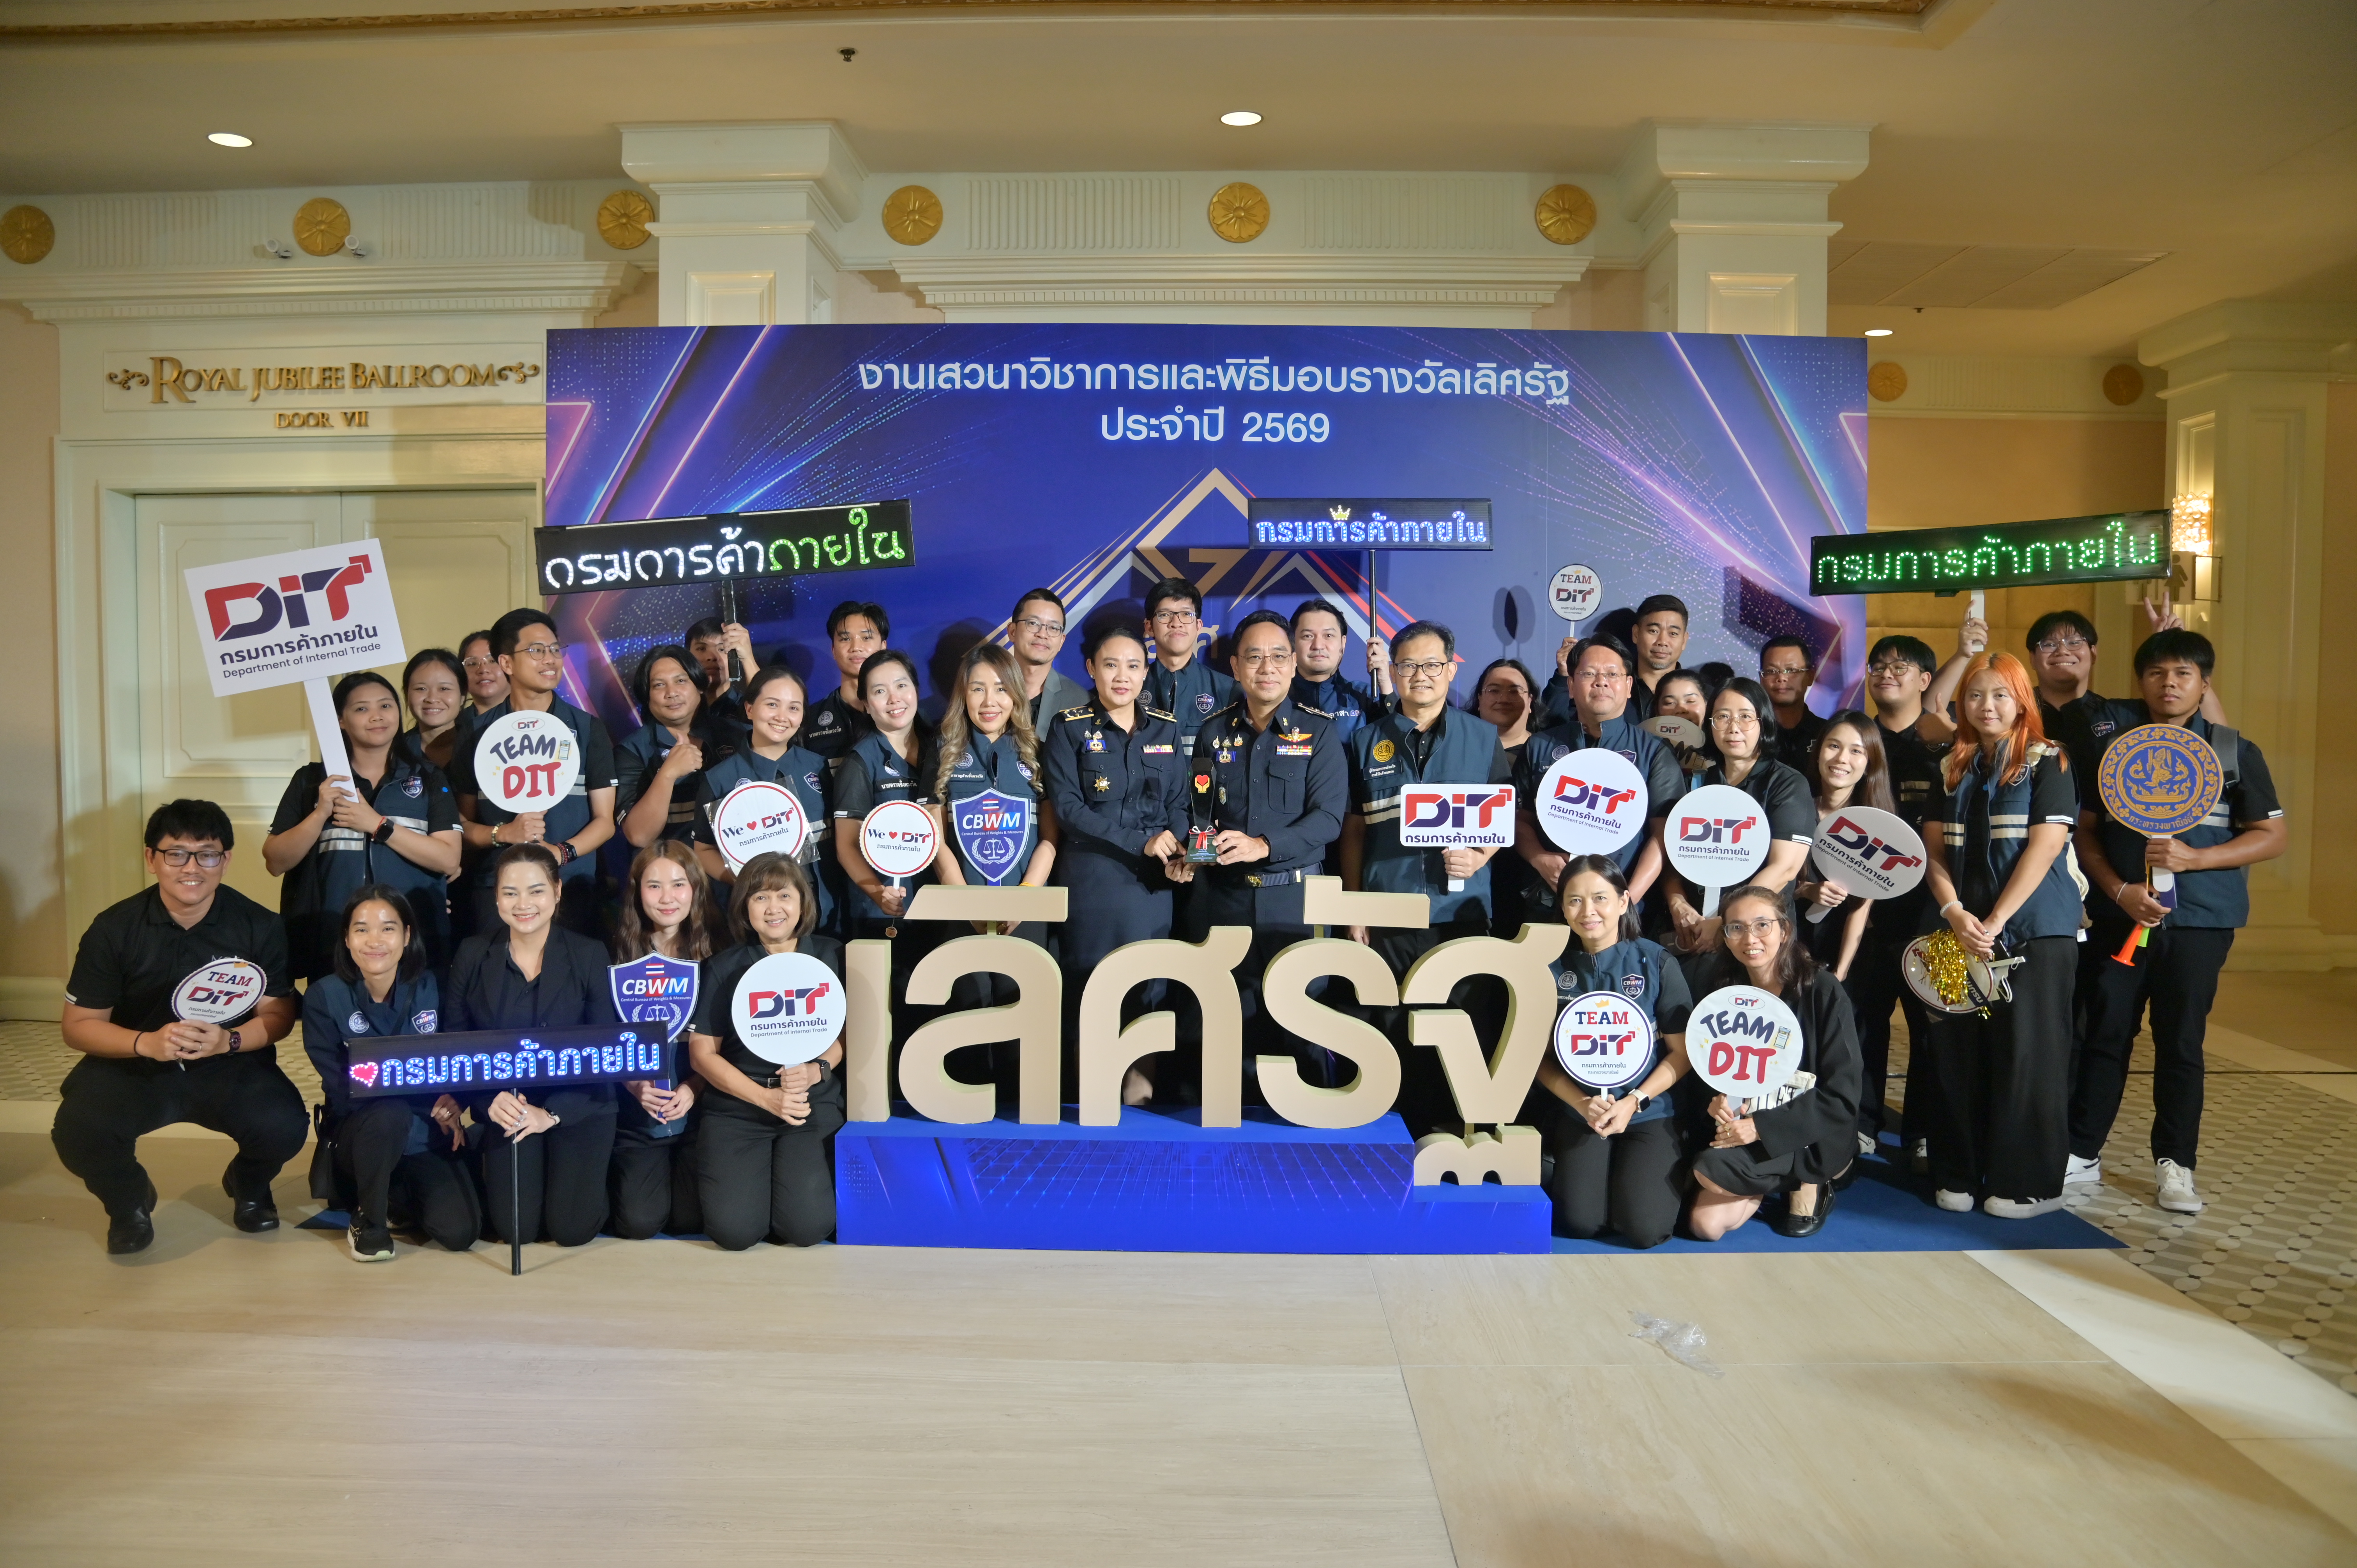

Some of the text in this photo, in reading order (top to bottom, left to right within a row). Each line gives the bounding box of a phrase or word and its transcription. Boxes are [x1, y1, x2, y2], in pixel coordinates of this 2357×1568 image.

[149, 356, 499, 404] ROYAL JUBILEE BALLROOM
[859, 357, 1569, 405] งานเสวนาวิชาการและพิธีมอบรางวัลเลิศรัฐ
[275, 411, 369, 429] DOOR VII
[1101, 405, 1330, 443] ประจำปี 2569
[1256, 511, 1487, 542] กรมการค้าภายใน
[545, 508, 905, 588] กรมการค้าภายใน
[1817, 521, 2157, 583] กรมการค้าภายใน
[1560, 574, 1592, 584] TEAM
[220, 624, 378, 665] กรมการค้าภายใน
[223, 643, 381, 678] Department of Internal Trade
[490, 734, 556, 764] TEAM
[503, 762, 562, 799] DIT
[962, 813, 1020, 829] CBWM
[1548, 812, 1578, 823] Department
[1584, 822, 1604, 831] Internal
[1550, 804, 1622, 829] กรมการค้าภายใน
[721, 826, 744, 839] We
[739, 828, 789, 846] กรมการค้าภายใน
[868, 828, 885, 839] We
[1405, 832, 1505, 844] กรมการค้าภายใน
[1679, 846, 1750, 856] กรมการค้าภายใน
[1819, 839, 1895, 888] กรมการค้าภายใน
[1815, 844, 1846, 866] Department
[1852, 867, 1874, 882] Internal
[1873, 880, 1889, 892] Trade
[207, 971, 254, 987] TEAM
[622, 978, 689, 995] CBWM
[416, 1014, 434, 1025] CBWM
[751, 1017, 827, 1031] กรมการค้าภายใน
[846, 875, 1571, 1187] เลิศรัฐ
[1575, 1011, 1629, 1025] TEAM
[1700, 1010, 1775, 1044] TEAM
[382, 1032, 660, 1087] กรมการค้าภายใน
[1708, 1042, 1776, 1084] DIT
